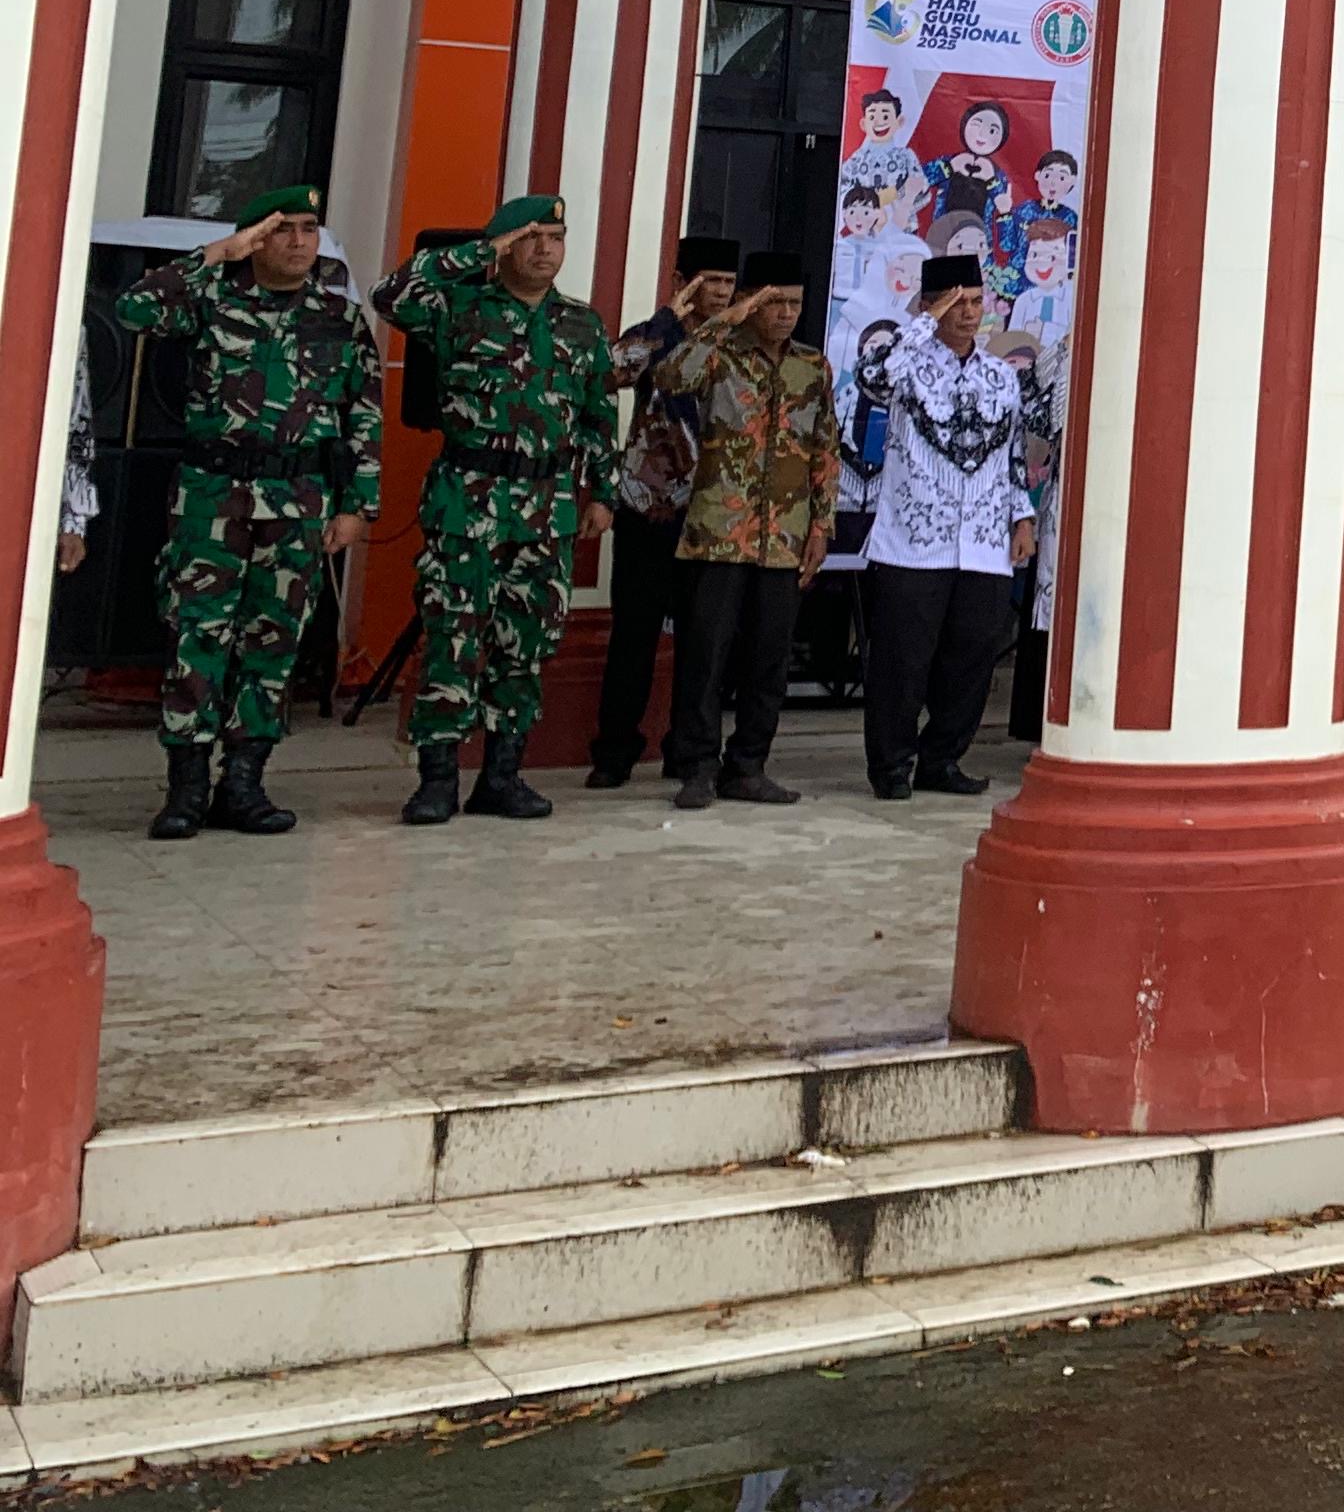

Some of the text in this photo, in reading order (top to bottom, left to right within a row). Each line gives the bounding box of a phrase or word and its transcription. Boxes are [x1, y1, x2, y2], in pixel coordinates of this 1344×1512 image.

[925, 10, 980, 27] GURU
[920, 23, 1022, 44] NASIONAL
[916, 37, 957, 50] 2025
